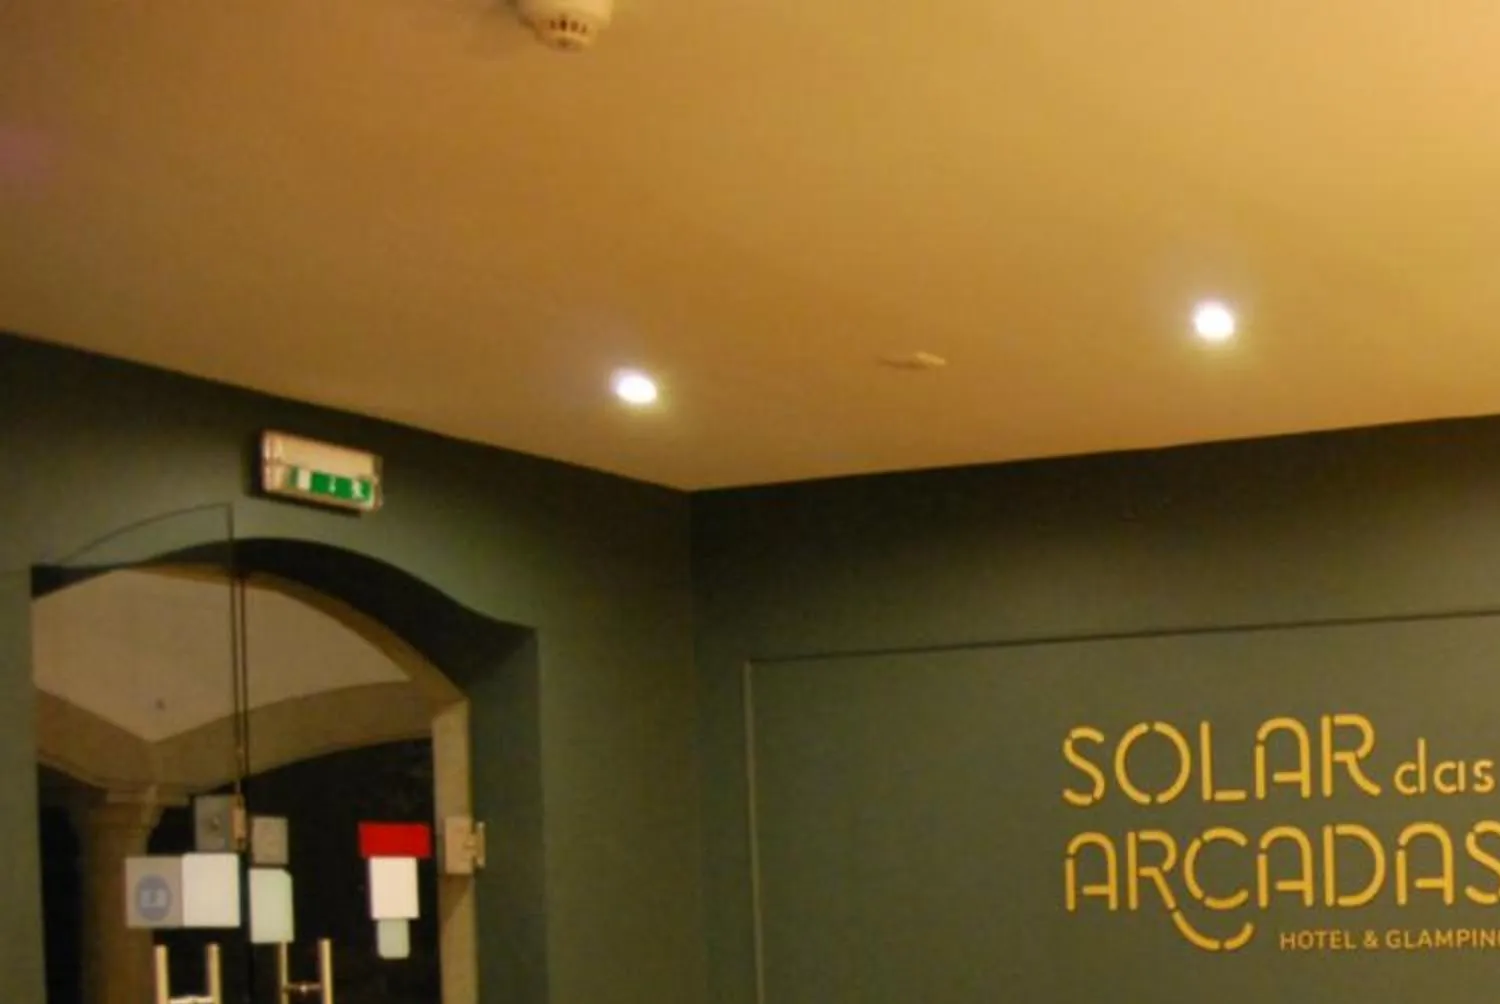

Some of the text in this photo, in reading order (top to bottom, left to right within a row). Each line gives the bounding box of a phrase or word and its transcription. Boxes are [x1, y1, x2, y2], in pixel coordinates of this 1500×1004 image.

[1062, 713, 1496, 806] SOLAR das
[1279, 928, 1358, 950] HOTEL
[1362, 929, 1380, 950] &
